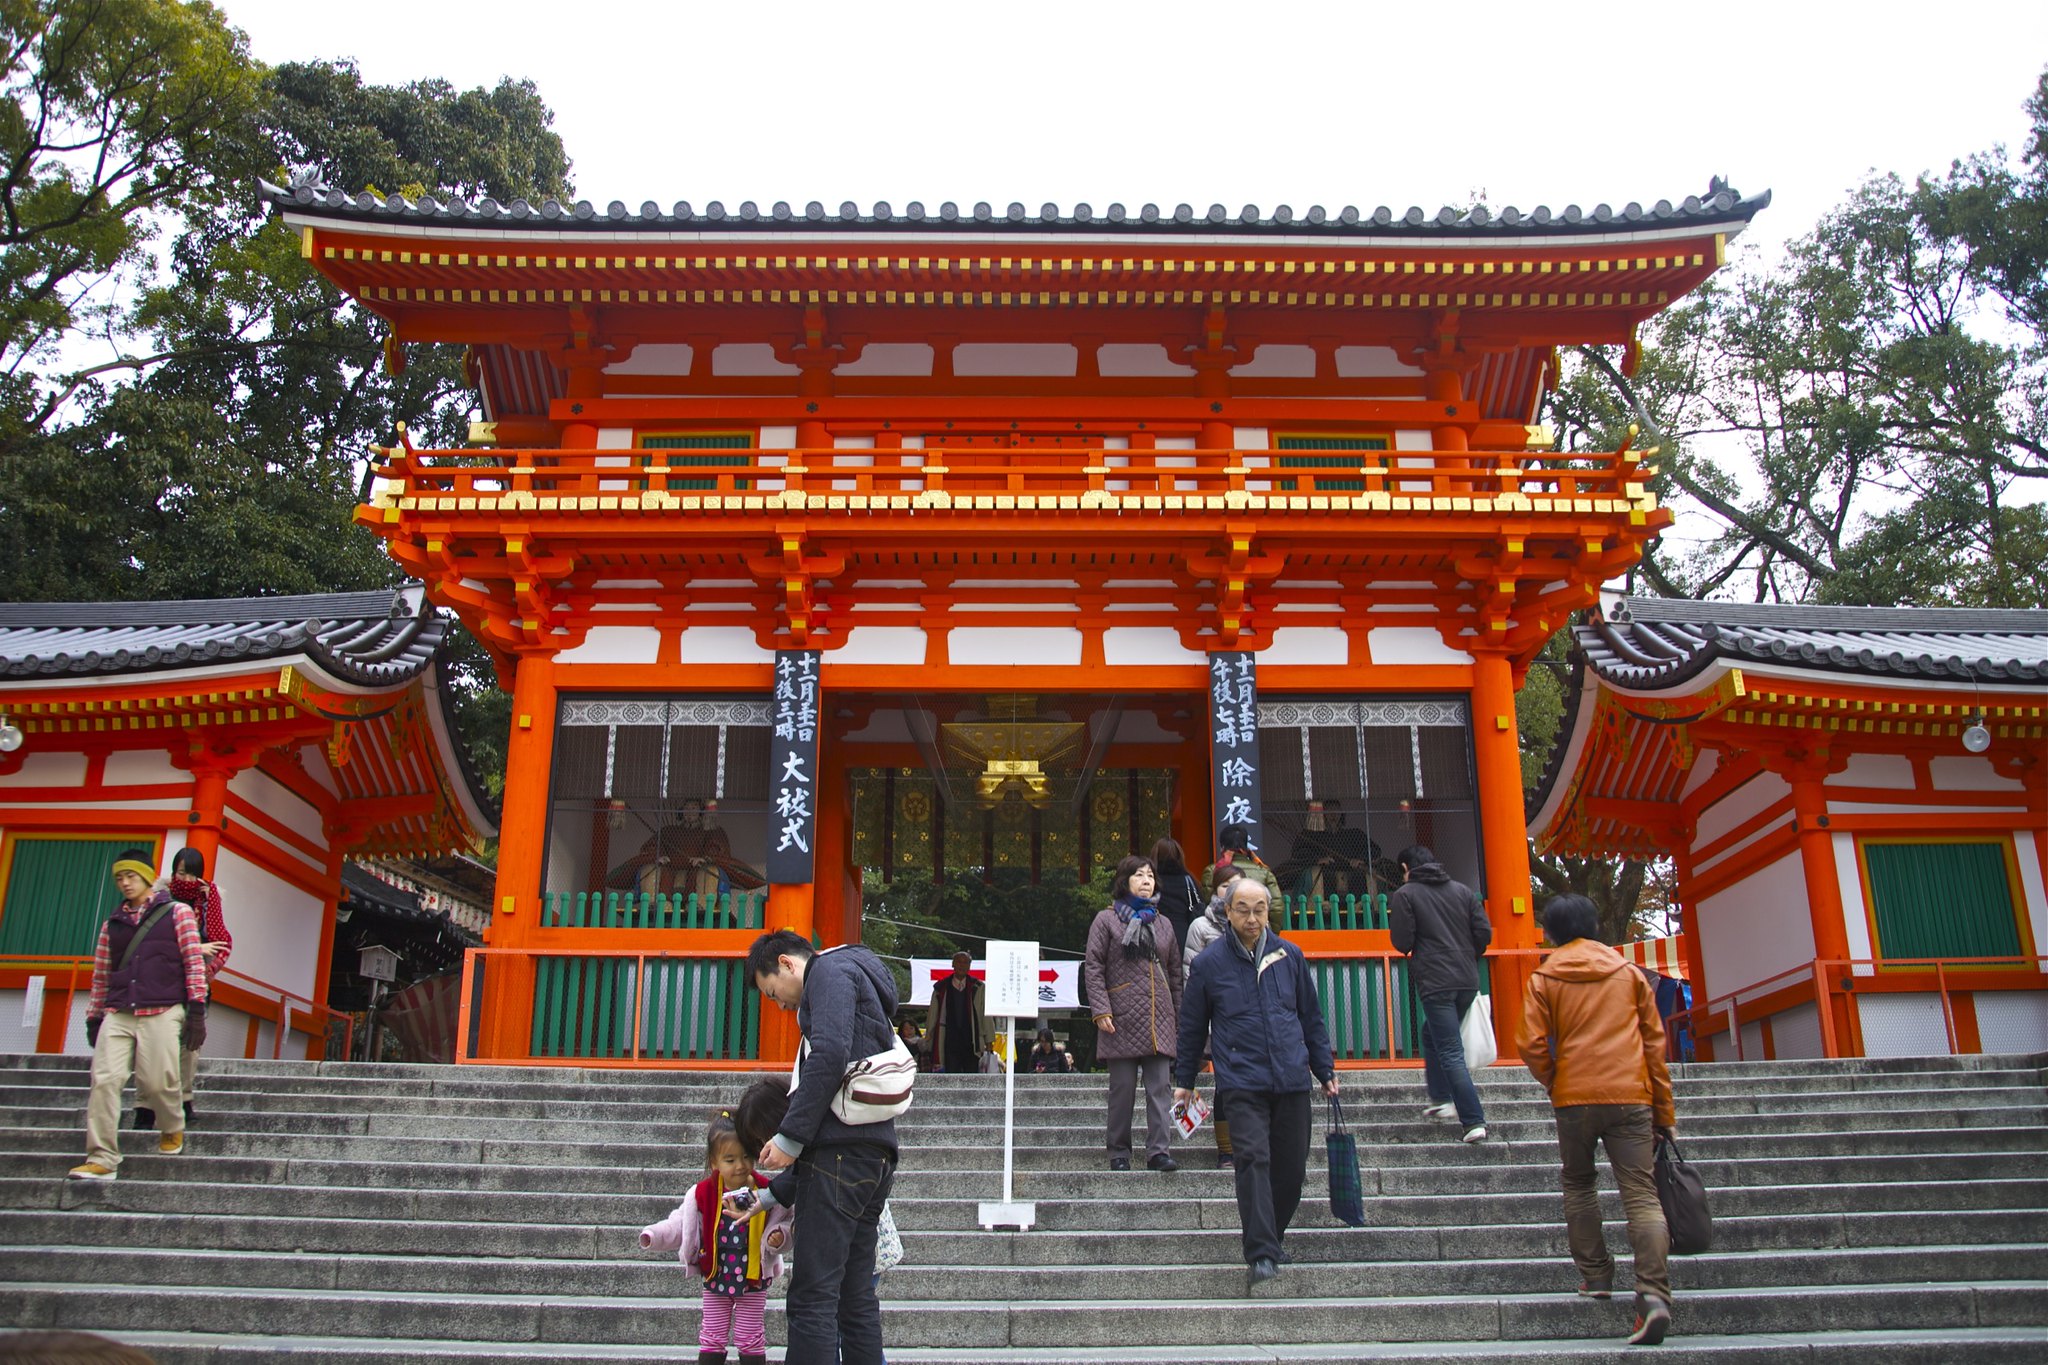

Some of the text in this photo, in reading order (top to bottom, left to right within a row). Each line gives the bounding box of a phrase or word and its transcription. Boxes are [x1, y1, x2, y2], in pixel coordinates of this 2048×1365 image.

[776, 656, 798, 741] 午後三時
[1211, 657, 1239, 748] 午後七時
[773, 750, 812, 853] 大祓式
[1221, 757, 1259, 851] 除夜
